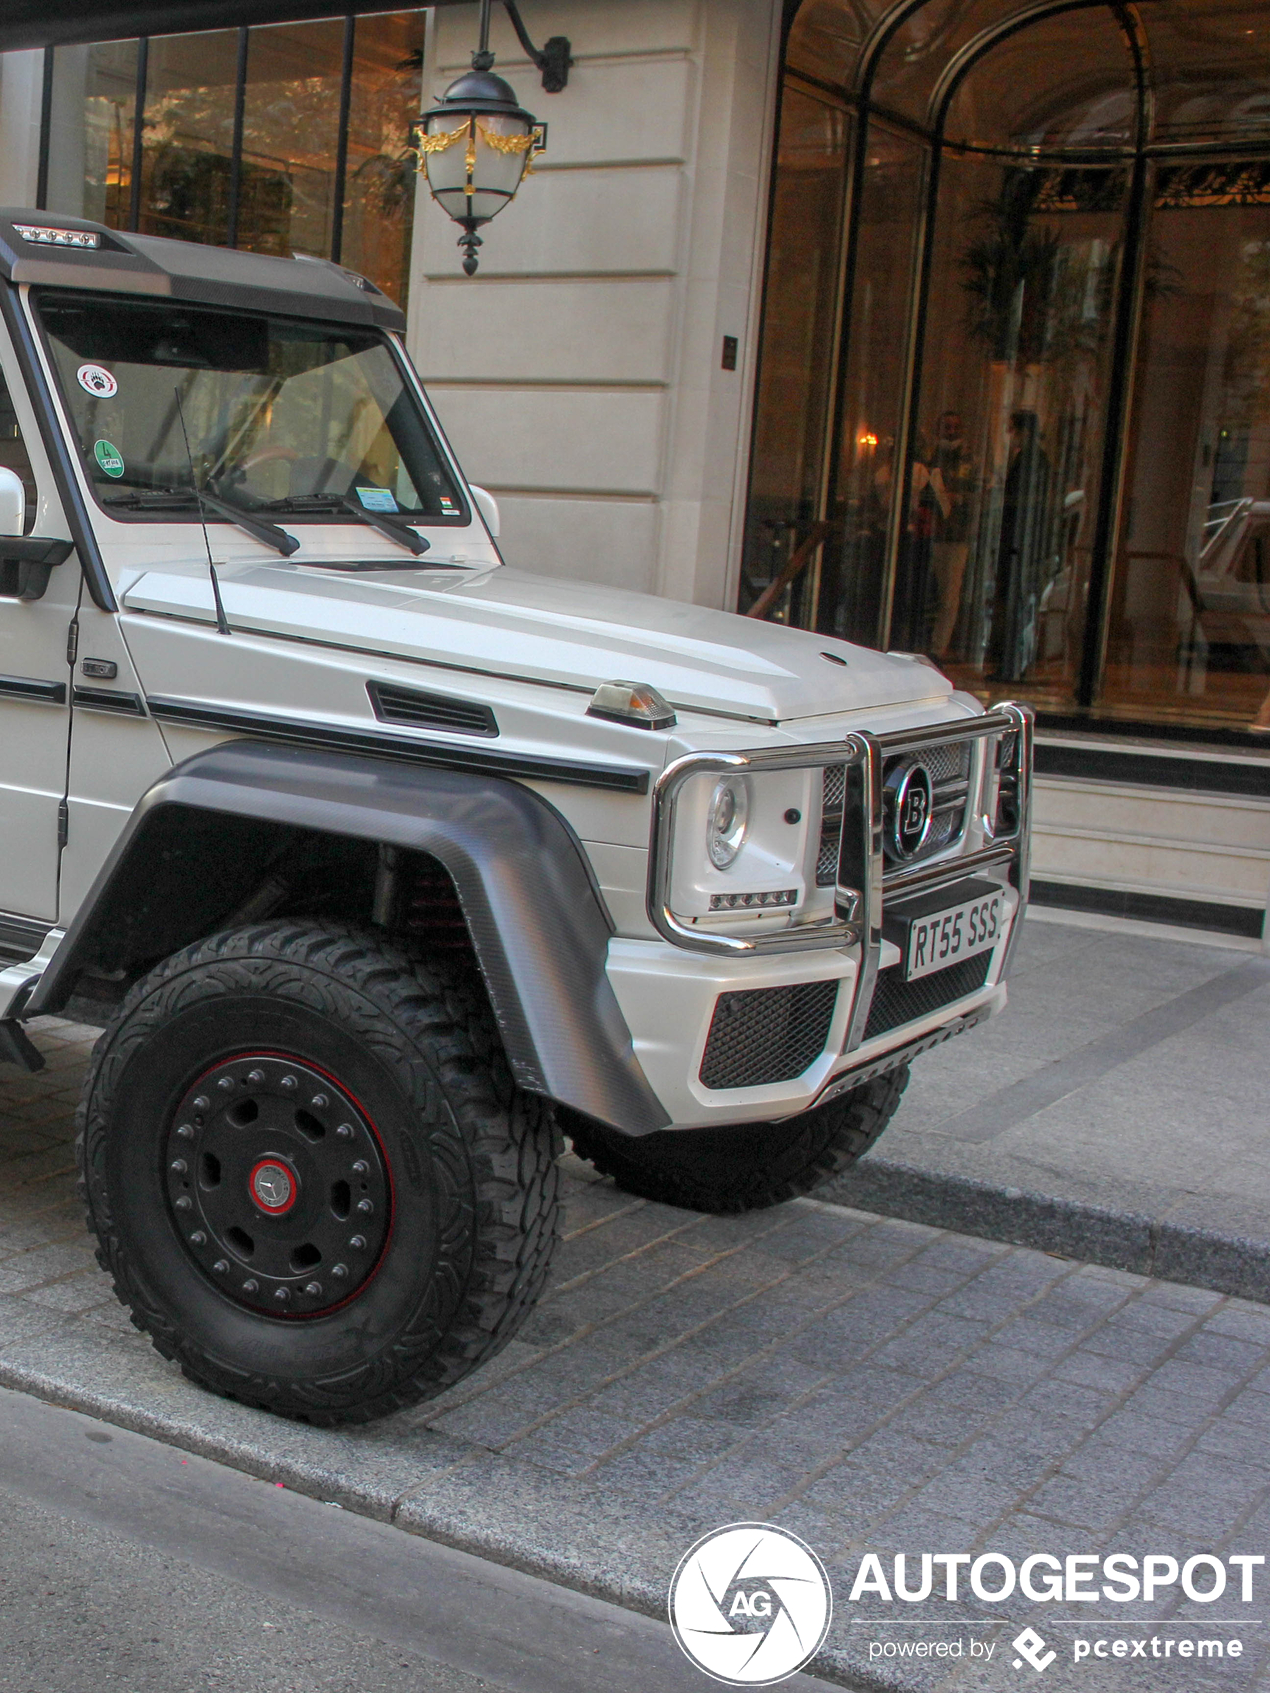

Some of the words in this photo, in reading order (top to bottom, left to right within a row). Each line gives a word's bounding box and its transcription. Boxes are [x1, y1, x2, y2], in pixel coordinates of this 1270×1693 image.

[904, 787, 926, 835] B
[914, 911, 964, 969] RT55
[967, 898, 999, 947] SSS
